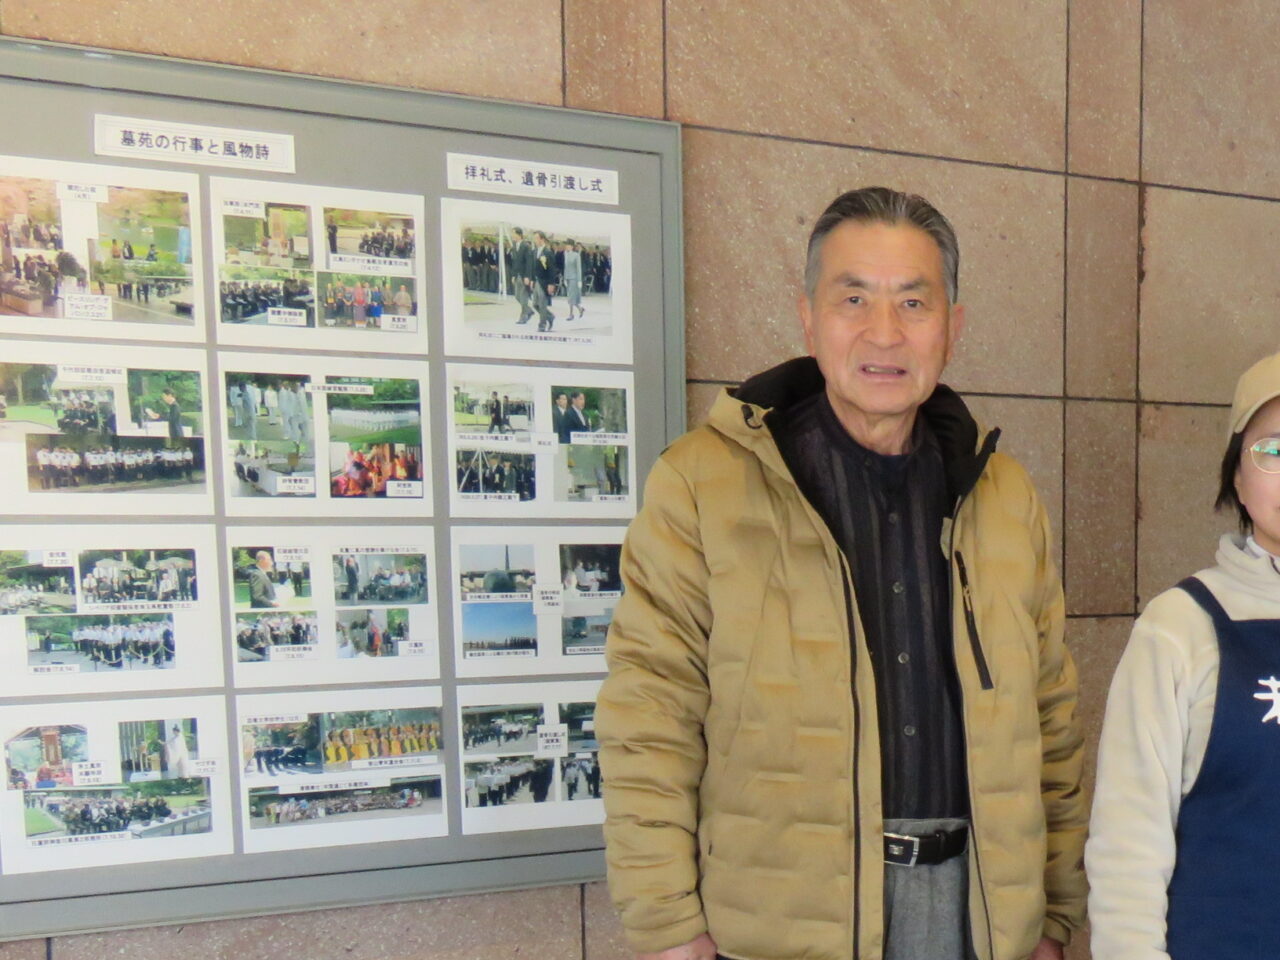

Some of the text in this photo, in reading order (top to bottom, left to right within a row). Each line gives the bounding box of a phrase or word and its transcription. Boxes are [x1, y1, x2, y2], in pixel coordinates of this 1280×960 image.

[120, 129, 270, 161] 墓苑の行事と風物詩
[464, 164, 603, 193] 拝礼式、遺骨引渡し式
